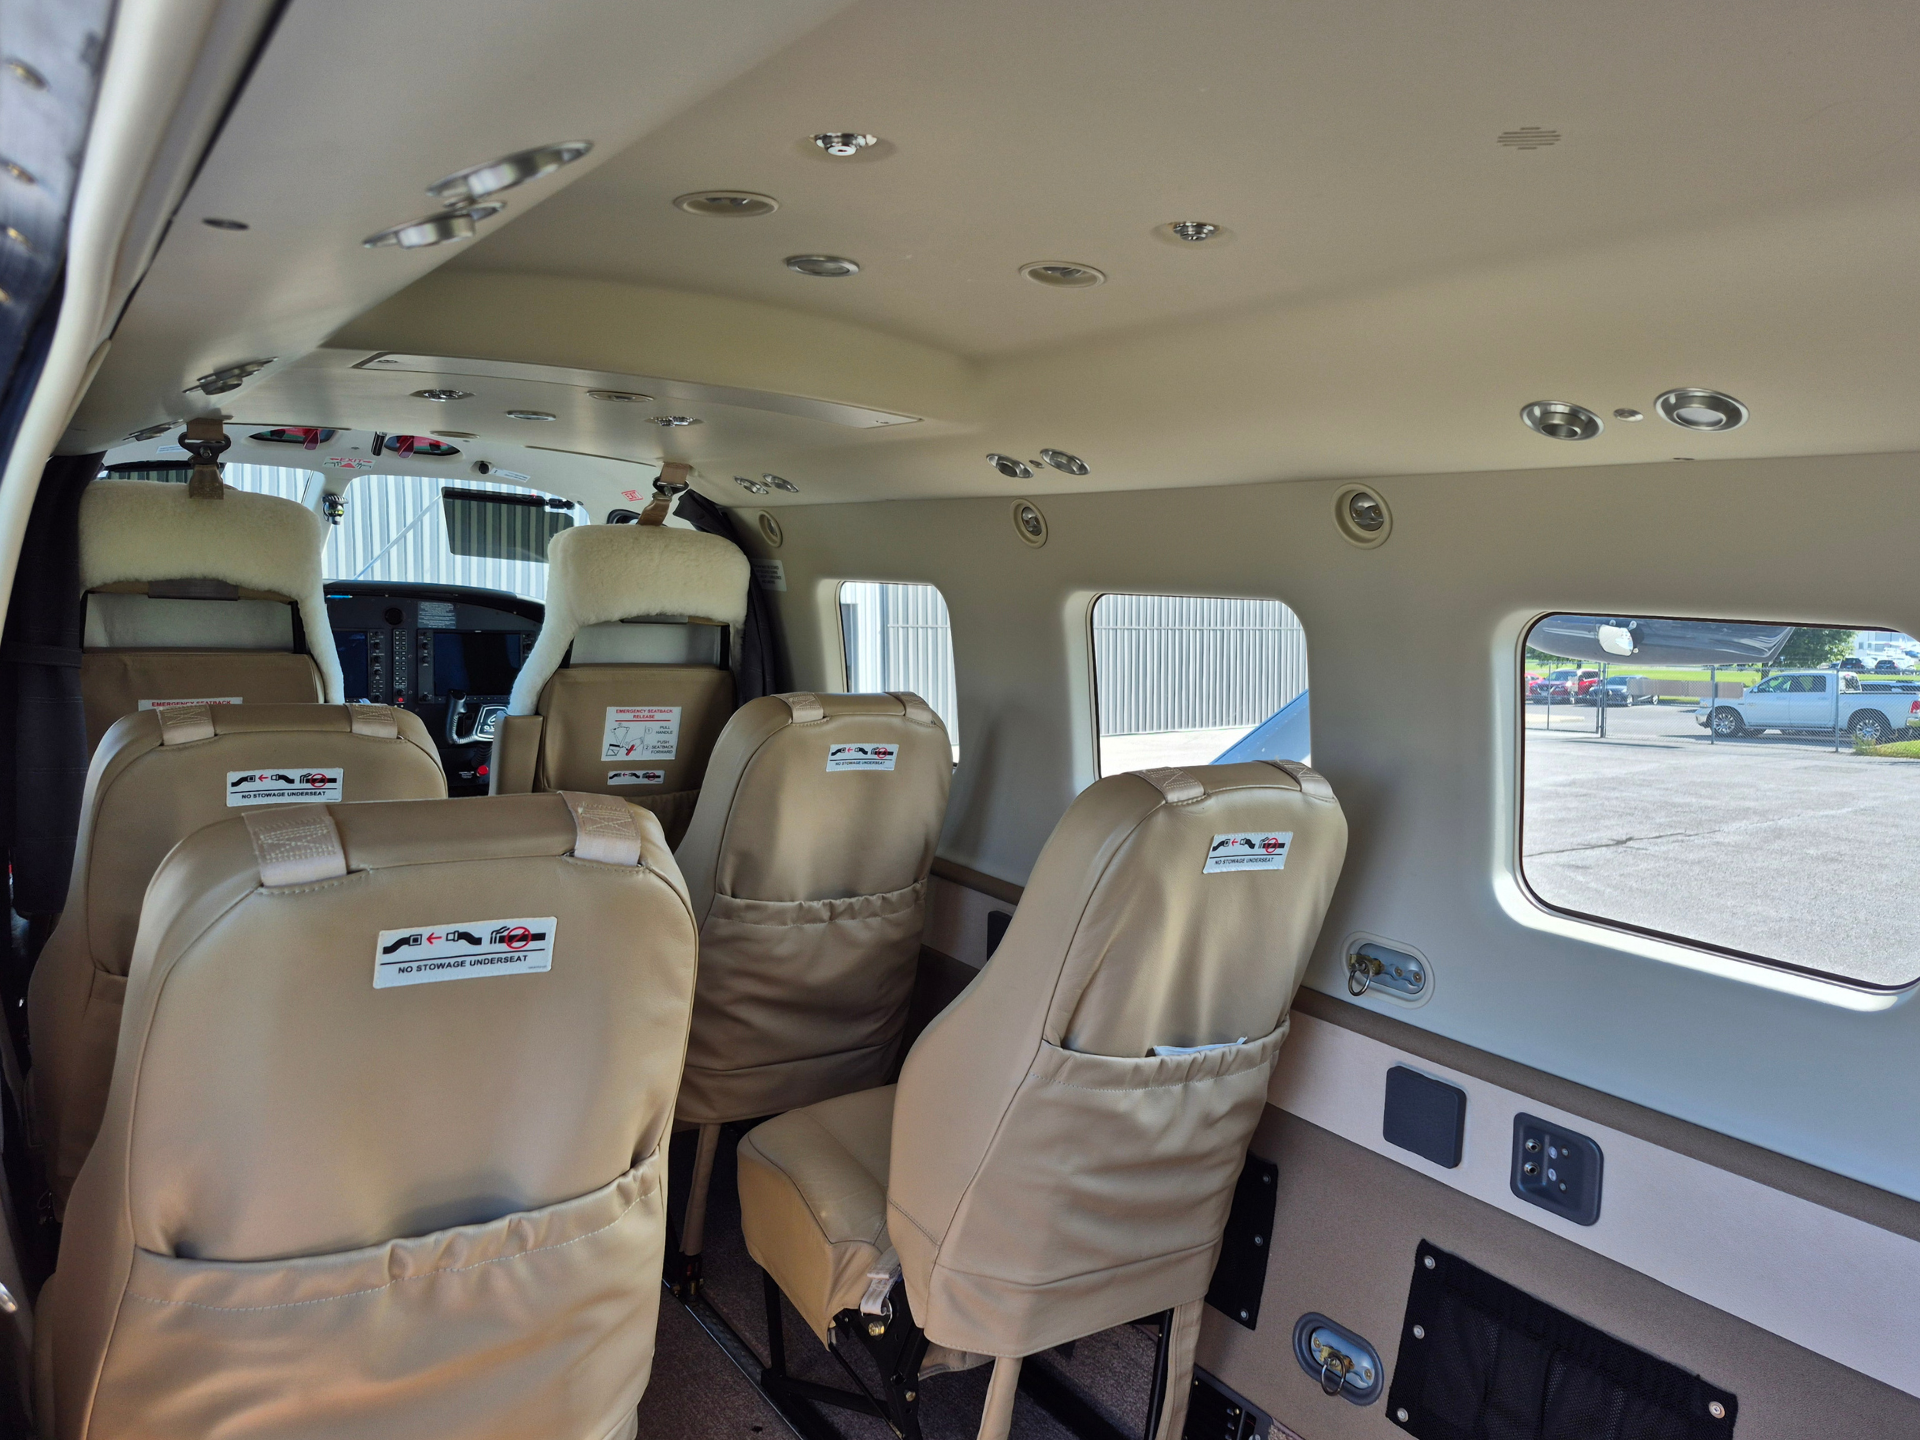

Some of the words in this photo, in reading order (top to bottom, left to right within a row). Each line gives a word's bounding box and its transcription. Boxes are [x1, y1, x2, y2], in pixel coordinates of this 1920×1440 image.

[253, 791, 285, 799] STOWAGE
[398, 966, 413, 974] NO
[416, 960, 467, 972] STOWAGE
[469, 955, 528, 967] UNDERSEAT
